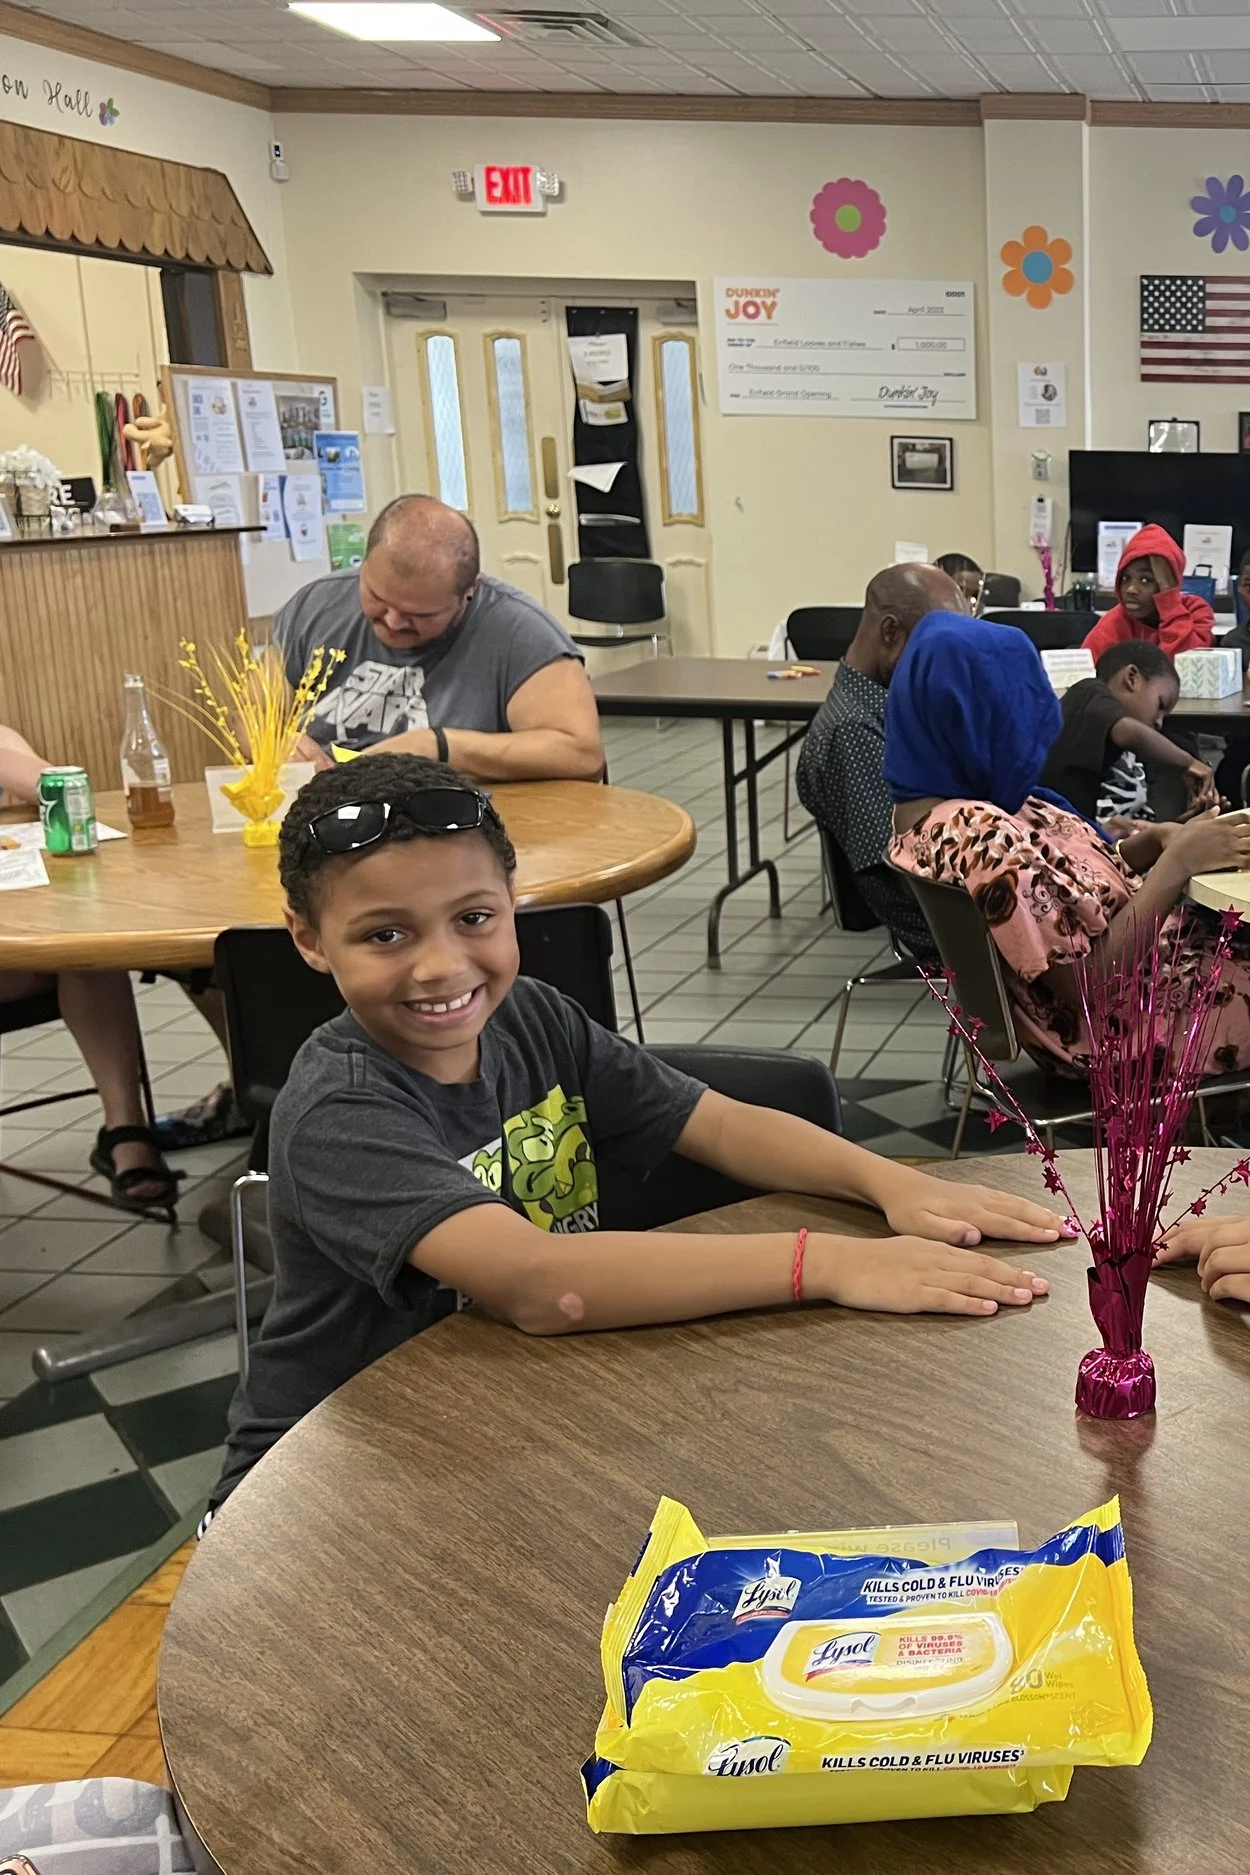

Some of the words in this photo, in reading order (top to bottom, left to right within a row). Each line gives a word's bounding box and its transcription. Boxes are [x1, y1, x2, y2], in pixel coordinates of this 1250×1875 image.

[42, 79, 94, 118] Hall
[484, 165, 533, 205] EXIT
[725, 299, 778, 320] JOY
[344, 660, 426, 698] STAR
[312, 685, 430, 742] WARS
[742, 1579, 797, 1609] Lysol
[863, 1580, 899, 1593] KILLS
[901, 1578, 936, 1592] COLD
[937, 1577, 947, 1589] &
[949, 1575, 974, 1587] FLU
[869, 1595, 898, 1603] TESTED
[905, 1593, 936, 1602] PROVEN
[811, 1634, 876, 1667] Lysol
[899, 1635, 928, 1643] KILLS
[916, 1641, 963, 1649] VIRUSES
[1010, 1669, 1043, 1695] 80
[1045, 1672, 1061, 1680] Wet
[1045, 1680, 1073, 1689] Wipes
[708, 1744, 784, 1777] Lysol
[822, 1757, 866, 1768] KILLS
[869, 1756, 910, 1767] COLD
[912, 1755, 922, 1766] &
[925, 1753, 955, 1765] FLU
